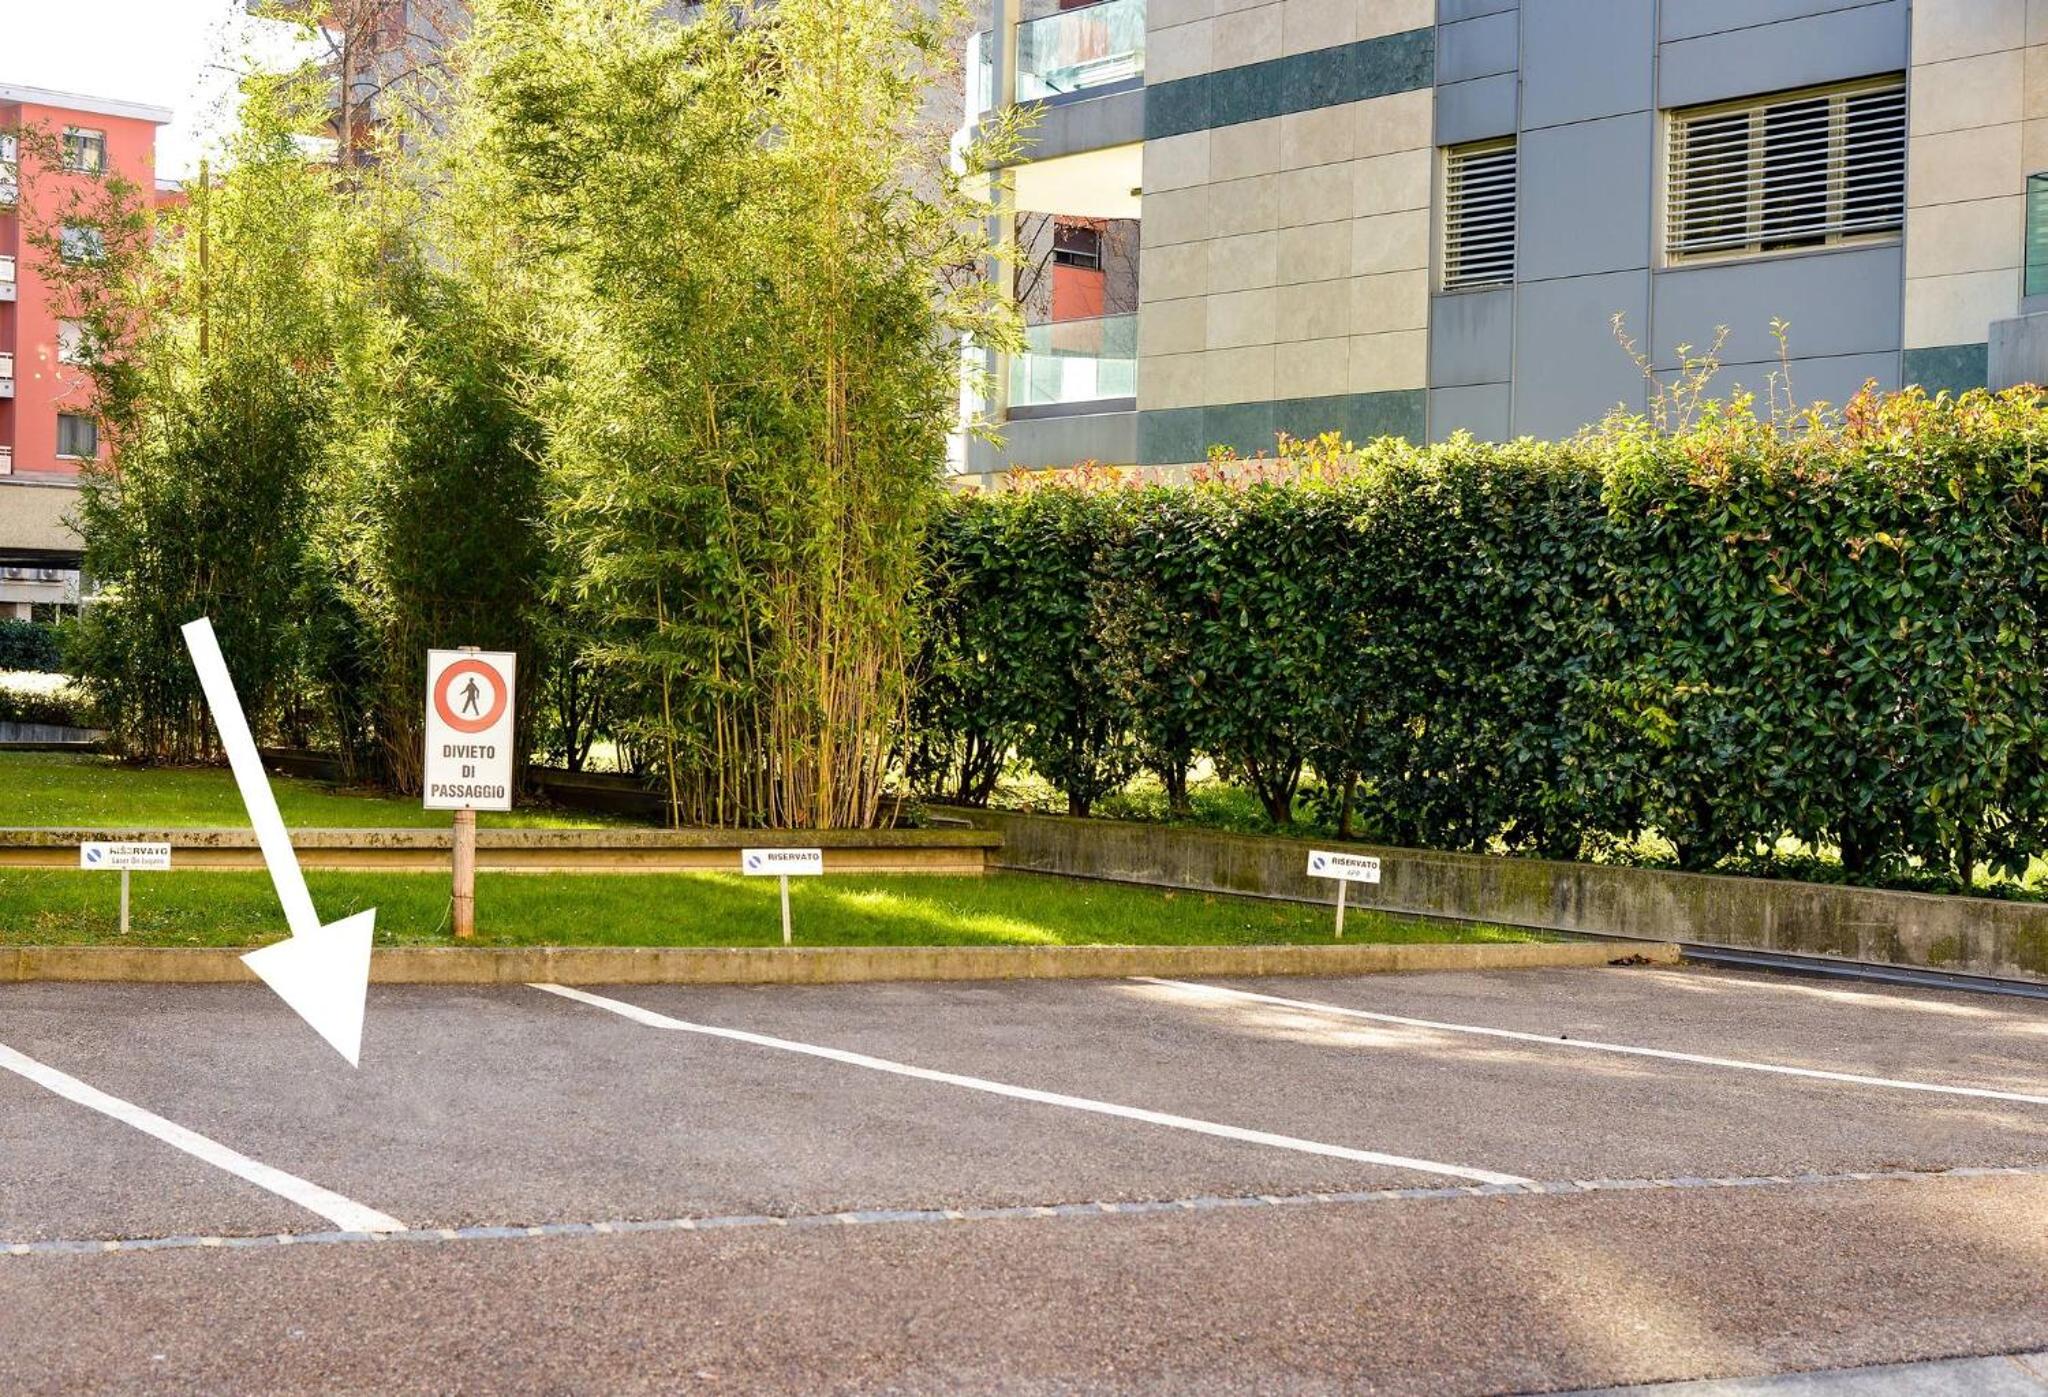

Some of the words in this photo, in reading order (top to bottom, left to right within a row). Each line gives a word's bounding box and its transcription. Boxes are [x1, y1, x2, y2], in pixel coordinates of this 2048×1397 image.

[443, 745, 495, 759] DIVIETO
[462, 765, 475, 778] DI
[431, 784, 505, 798] PASSAGGIO
[768, 853, 819, 861] RISERVATO
[1332, 857, 1378, 869] RISERVATO
